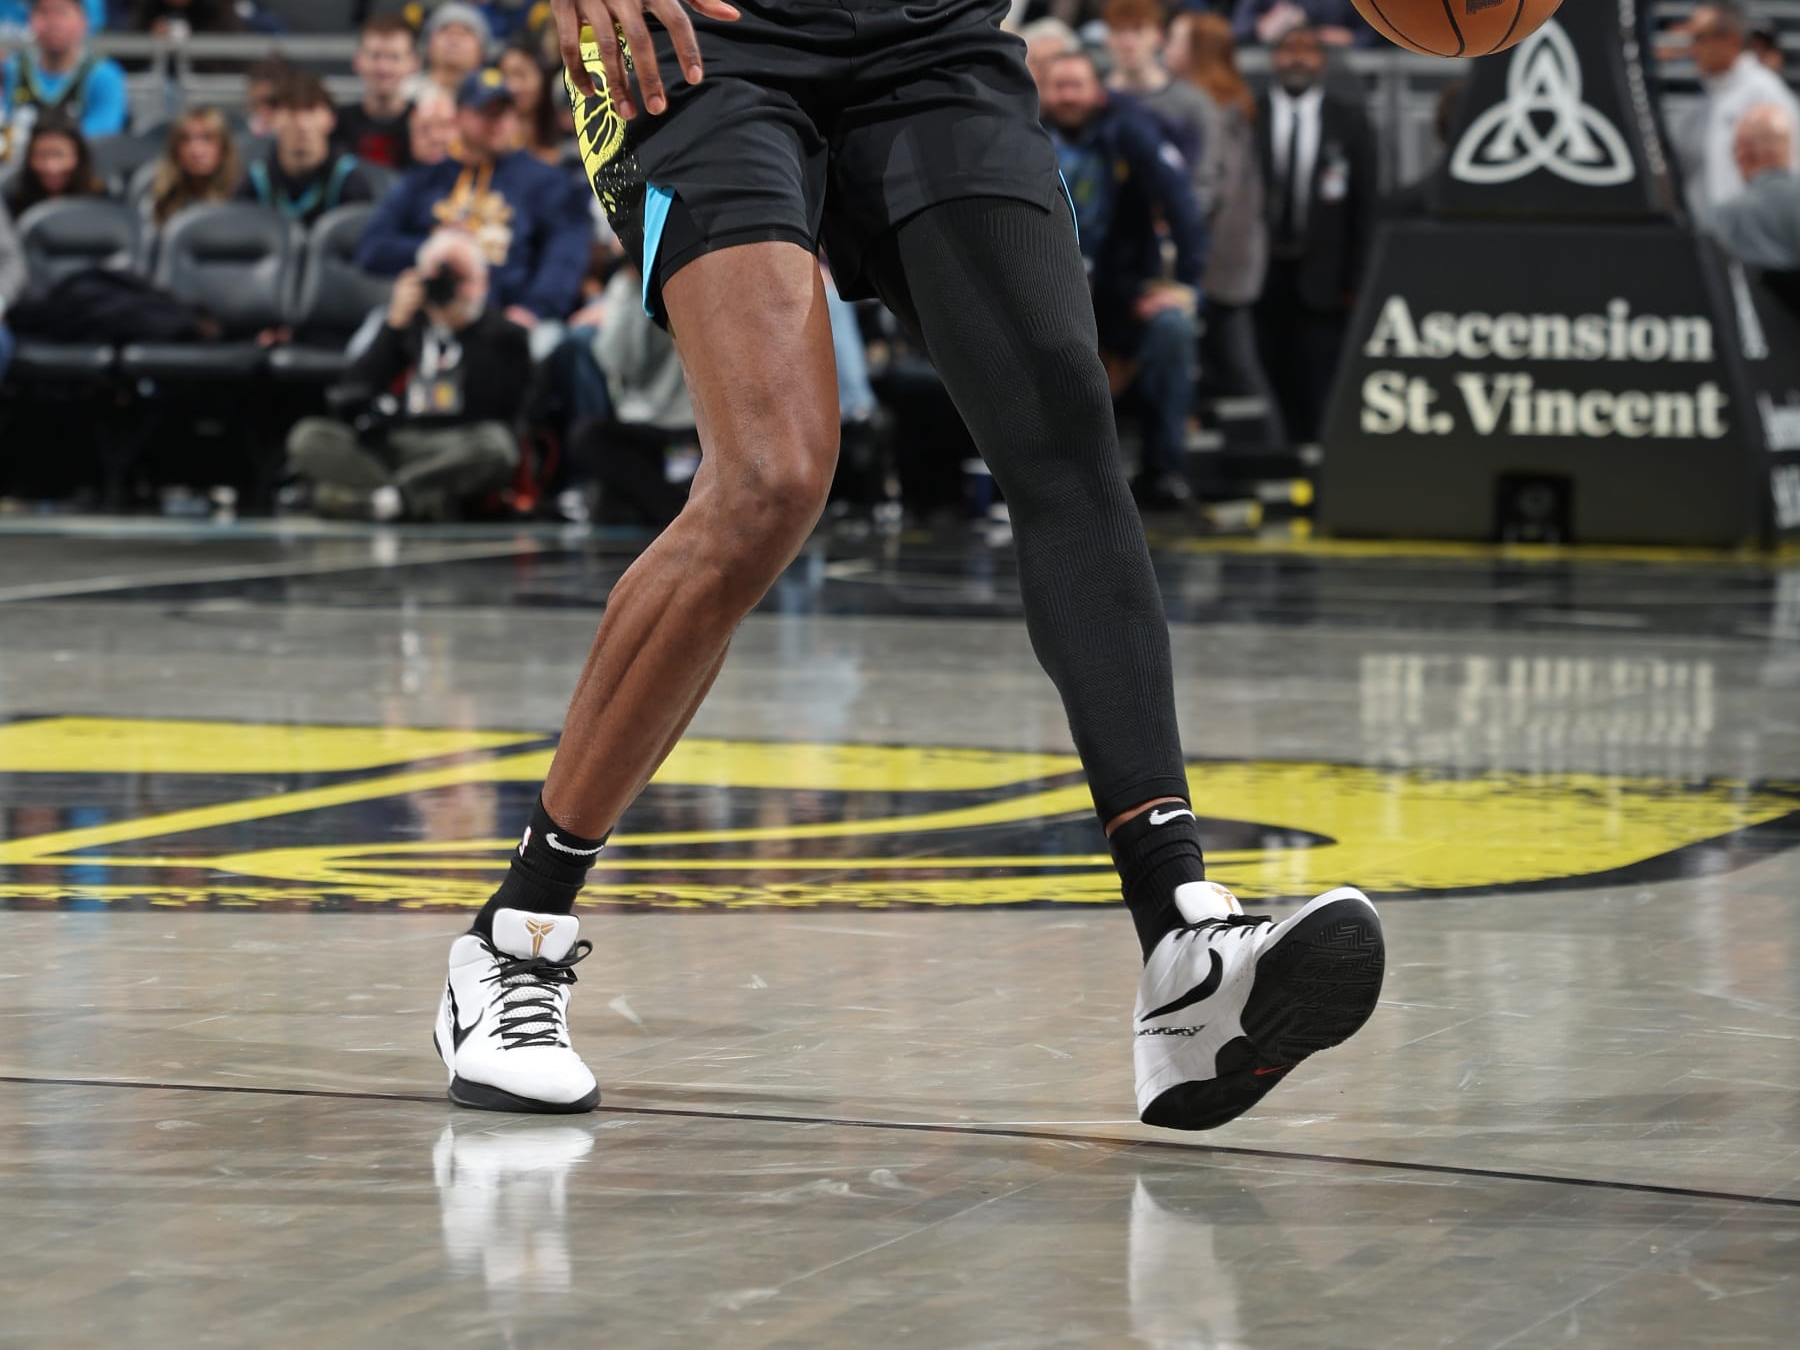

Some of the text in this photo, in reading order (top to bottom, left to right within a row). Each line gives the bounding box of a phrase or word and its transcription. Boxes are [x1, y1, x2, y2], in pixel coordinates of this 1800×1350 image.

[1365, 294, 1714, 362] Ascension
[1360, 370, 1729, 438] St. Vincent
